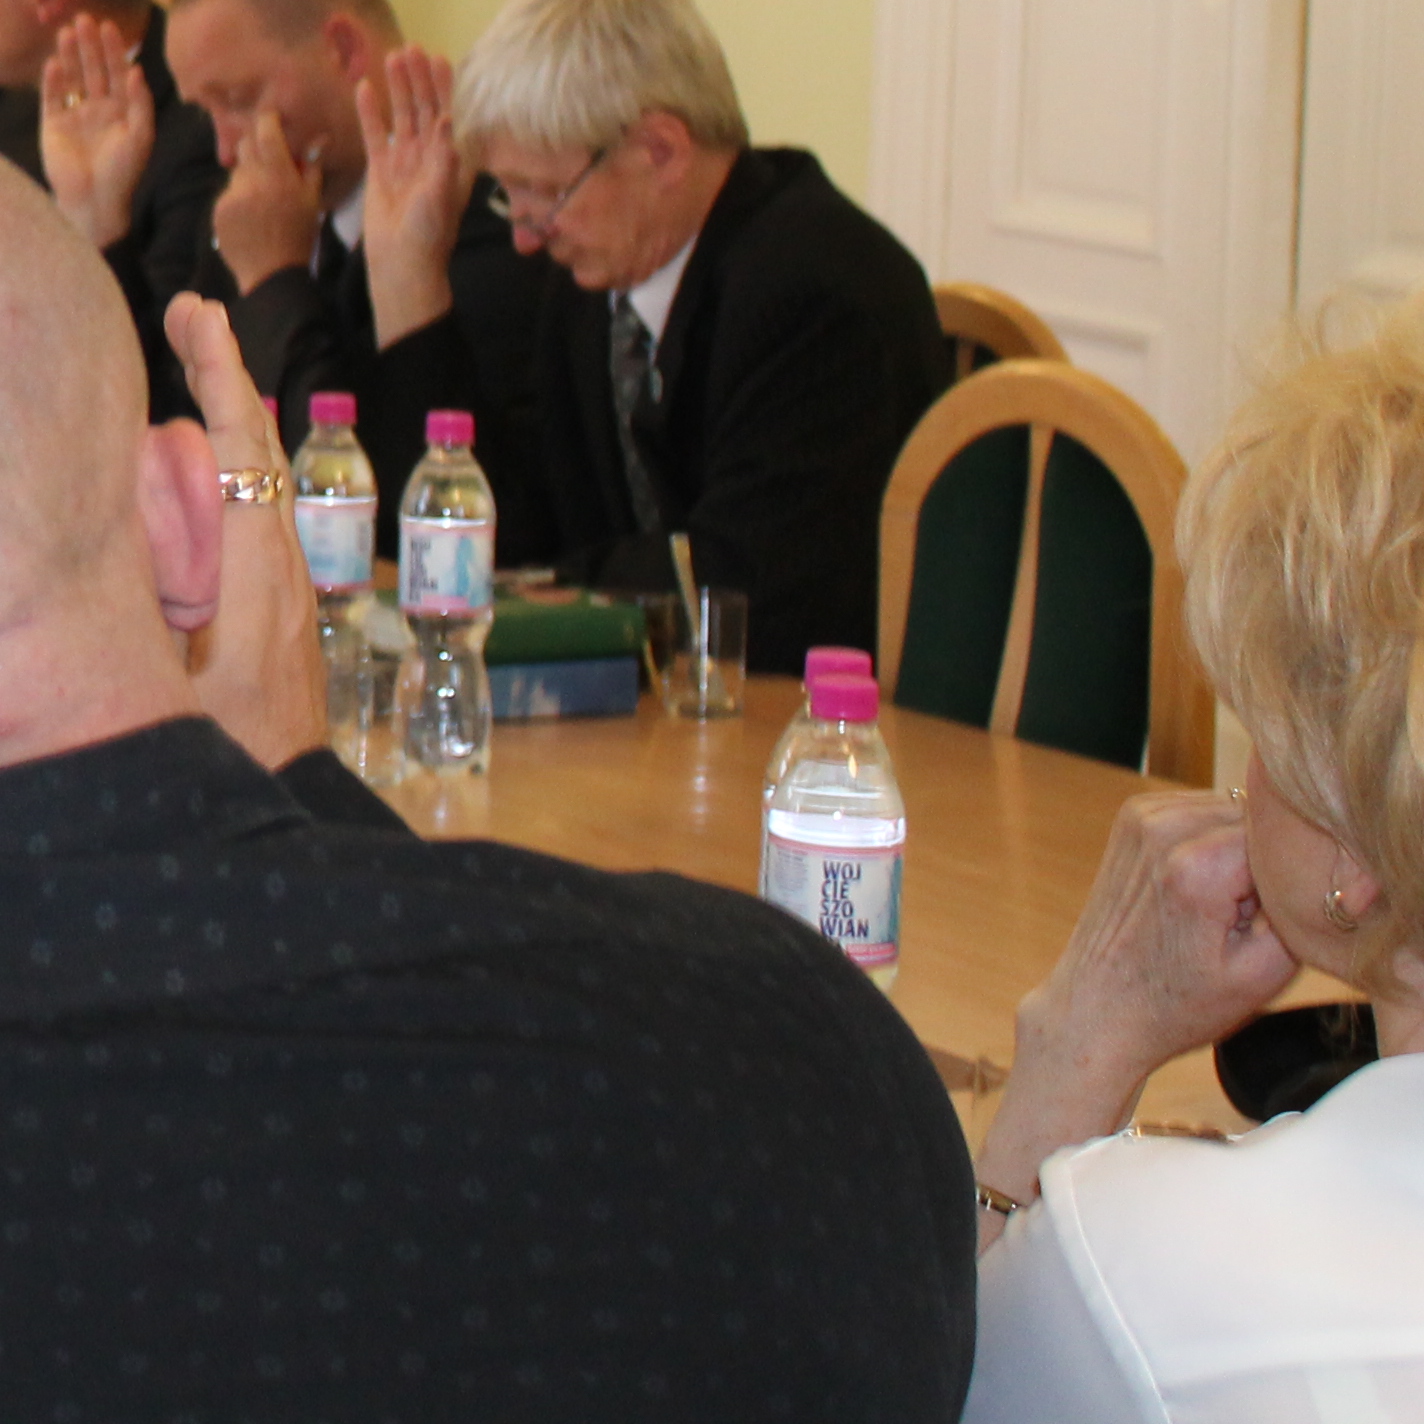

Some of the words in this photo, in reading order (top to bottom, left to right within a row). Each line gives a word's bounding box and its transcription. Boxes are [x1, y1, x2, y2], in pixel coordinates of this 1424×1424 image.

[823, 861, 861, 880] WOJ
[821, 879, 850, 899] CIE
[820, 899, 854, 918] SZO
[819, 917, 869, 938] WIAN
